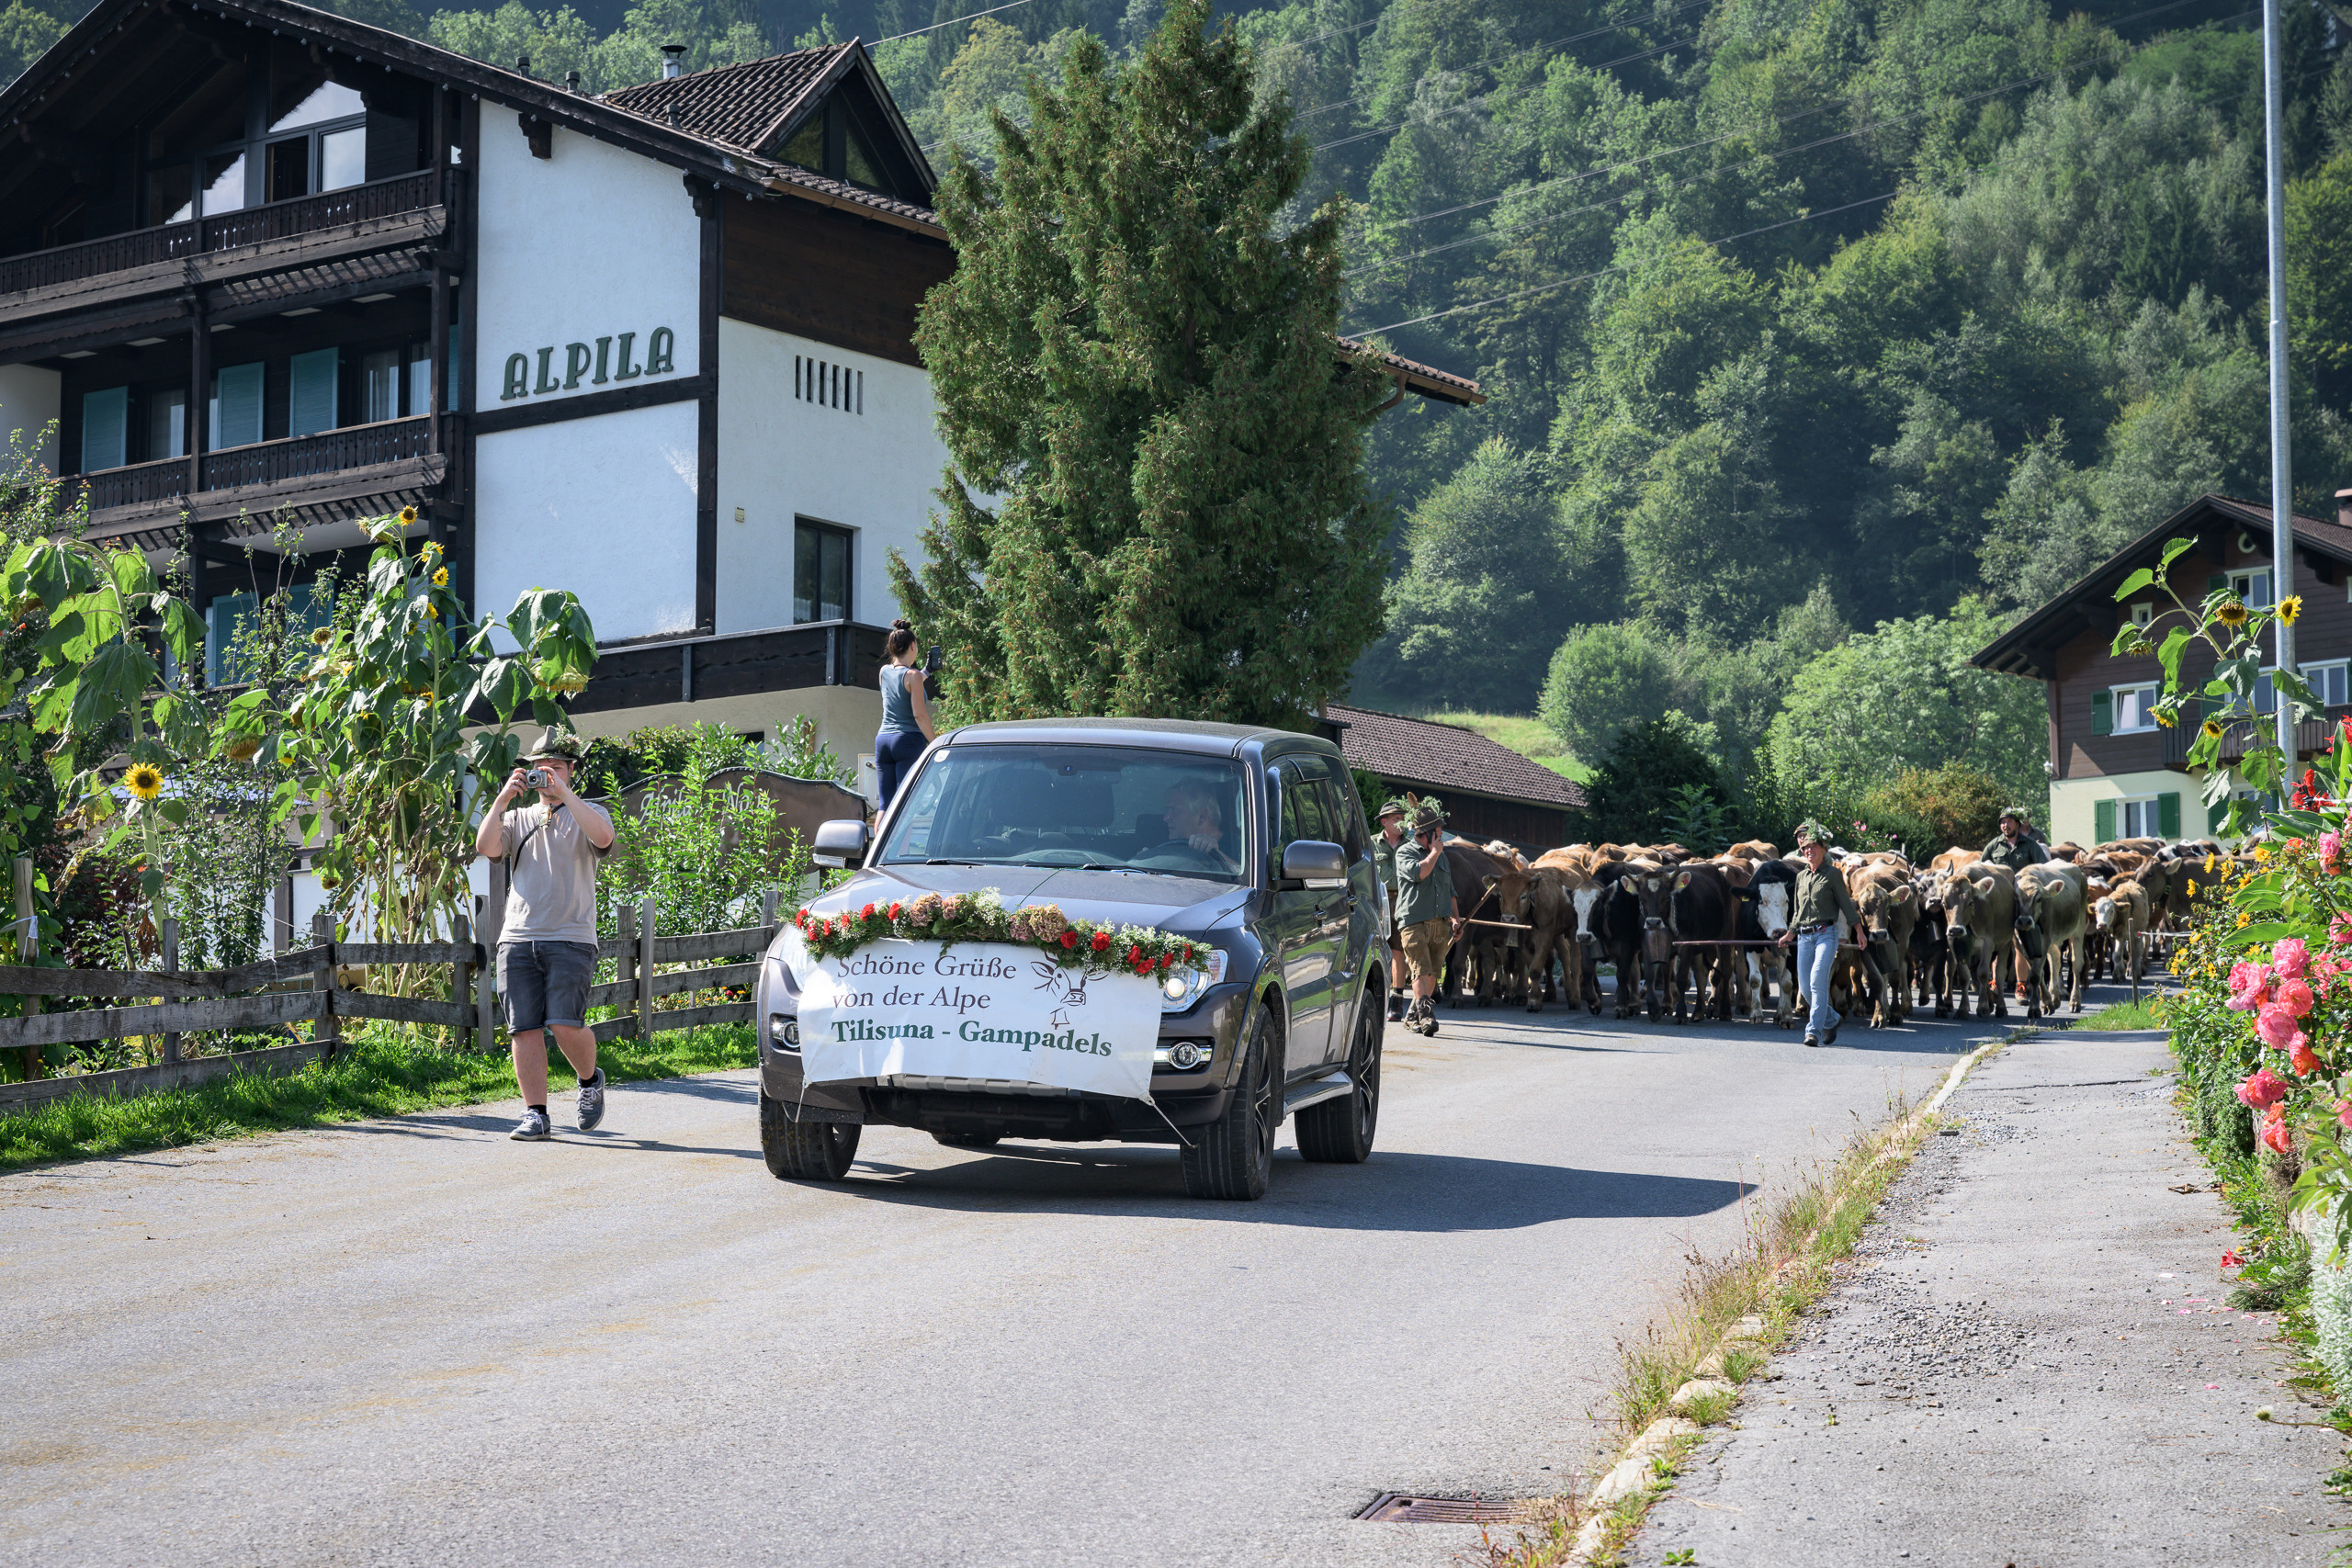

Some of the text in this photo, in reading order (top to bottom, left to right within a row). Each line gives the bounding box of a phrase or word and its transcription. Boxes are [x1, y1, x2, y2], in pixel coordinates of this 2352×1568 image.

[500, 326, 673, 400] ALPILA
[837, 953, 1017, 979] Schöne Grüße
[833, 985, 991, 1015] von der Alpe
[831, 1019, 934, 1043] Tilisuna
[958, 1021, 1112, 1056] Gampadels
